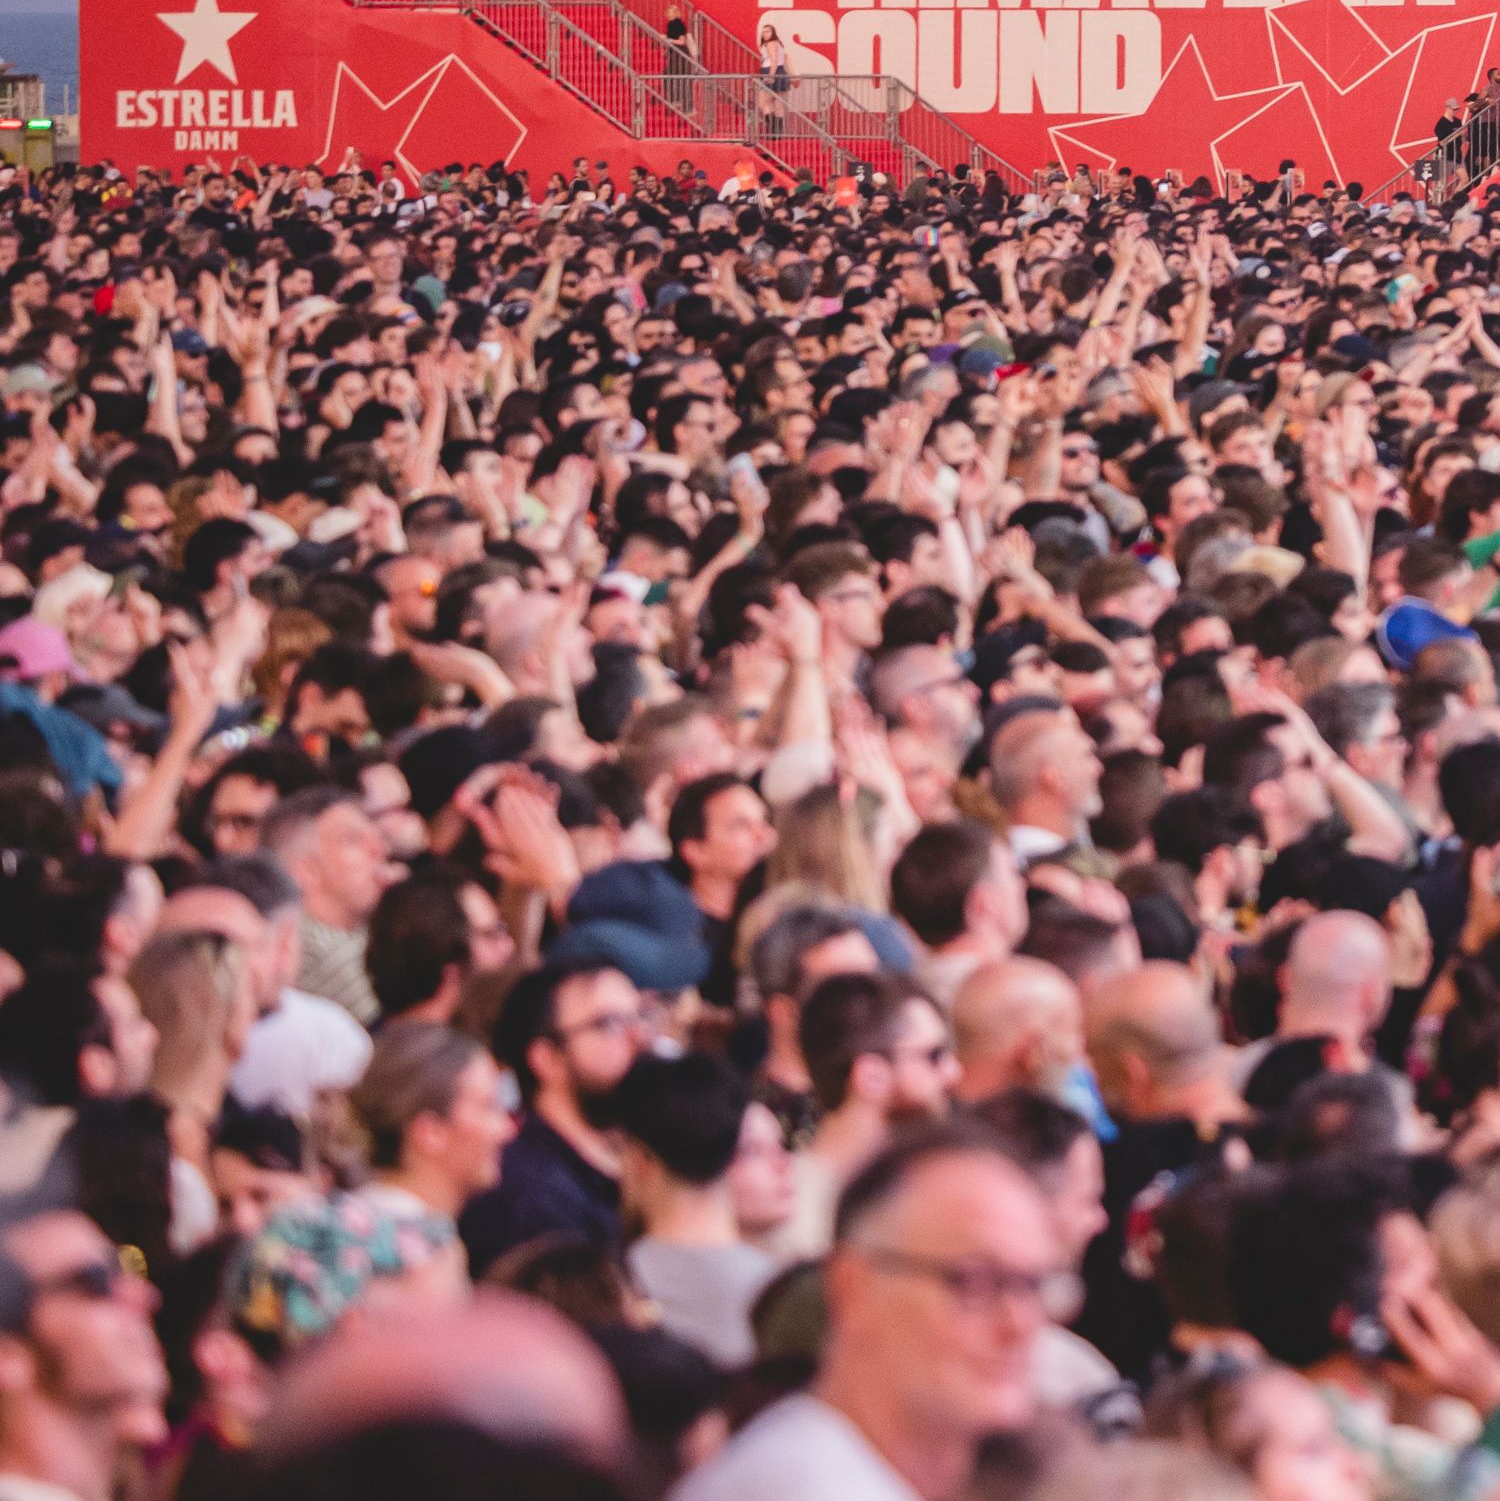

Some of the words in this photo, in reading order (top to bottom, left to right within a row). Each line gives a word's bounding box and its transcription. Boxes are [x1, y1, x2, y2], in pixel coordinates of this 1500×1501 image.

[757, 9, 1162, 115] SOUND
[116, 89, 298, 129] ESTRELLA
[174, 130, 239, 151] DAMM
